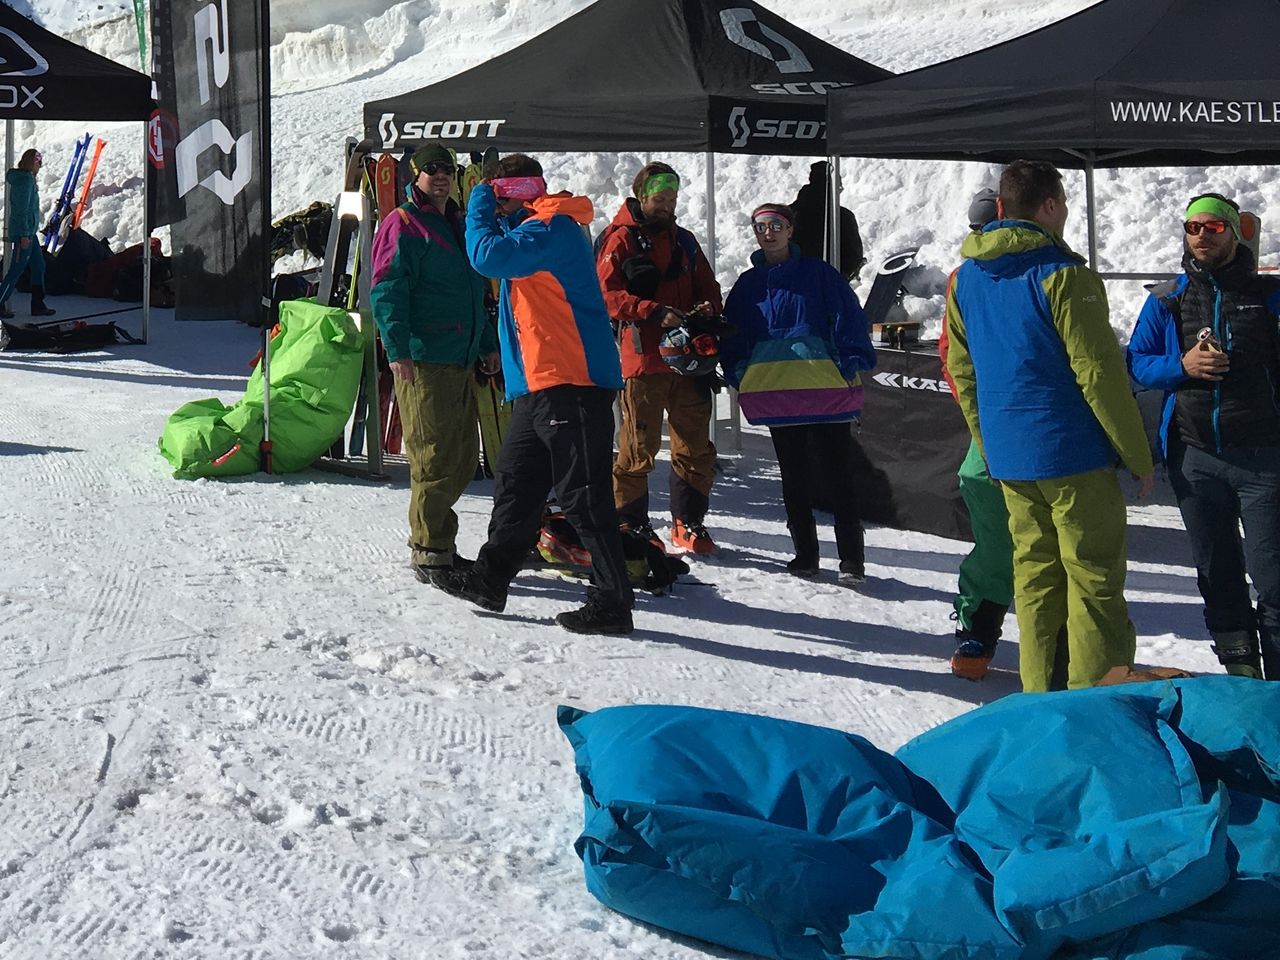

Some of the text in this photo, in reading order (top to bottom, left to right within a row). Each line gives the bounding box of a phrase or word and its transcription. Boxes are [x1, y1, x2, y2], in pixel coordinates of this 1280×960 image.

[751, 82, 854, 95] SCO
[1110, 101, 1280, 123] WWW.KAESTLE
[400, 119, 507, 140] SCOTT
[752, 119, 826, 140] SCO
